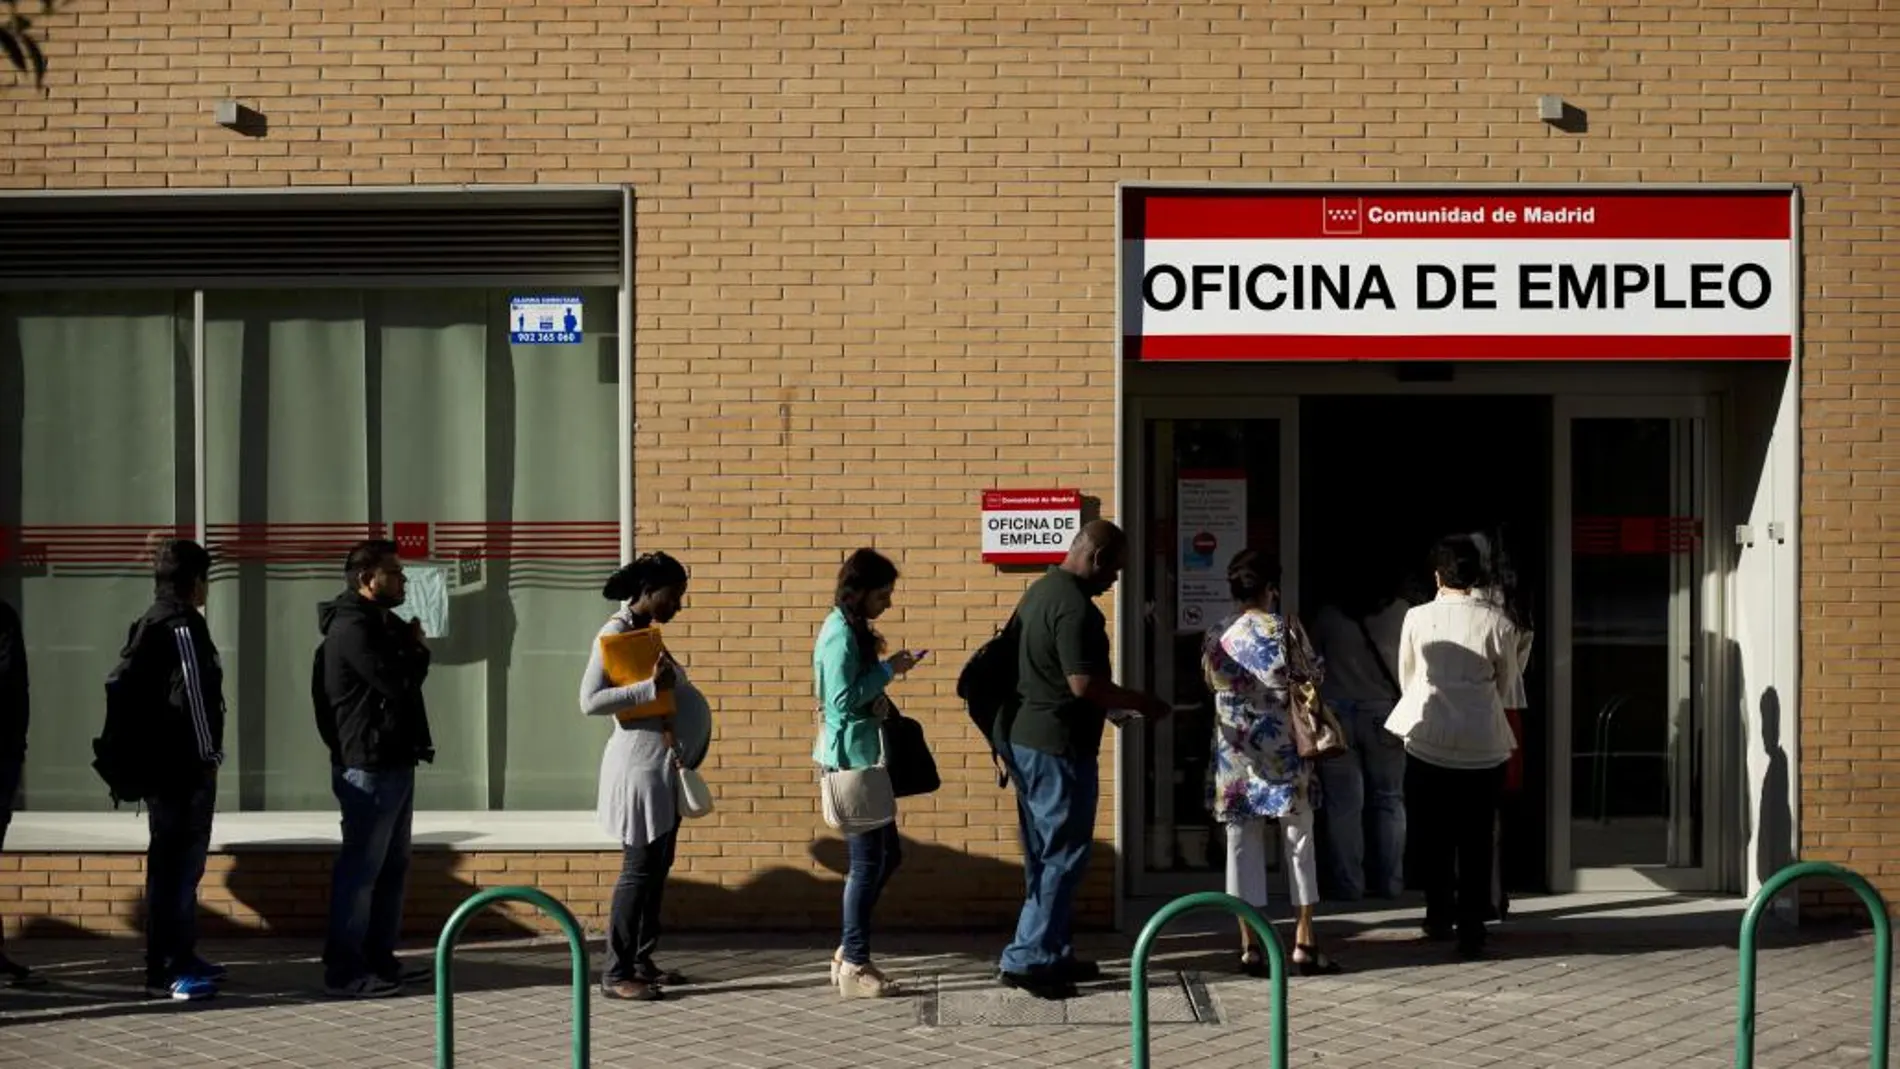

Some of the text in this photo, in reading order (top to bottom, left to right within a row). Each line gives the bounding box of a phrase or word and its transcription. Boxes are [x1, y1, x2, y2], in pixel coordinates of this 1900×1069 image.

[1368, 206, 1595, 224] Comunidad de Madrid
[1141, 262, 1772, 311] OFICINA DE EMPLEO
[517, 333, 535, 342] 902
[988, 517, 1075, 530] OFICINA DE
[1000, 532, 1063, 546] EMPLEO
